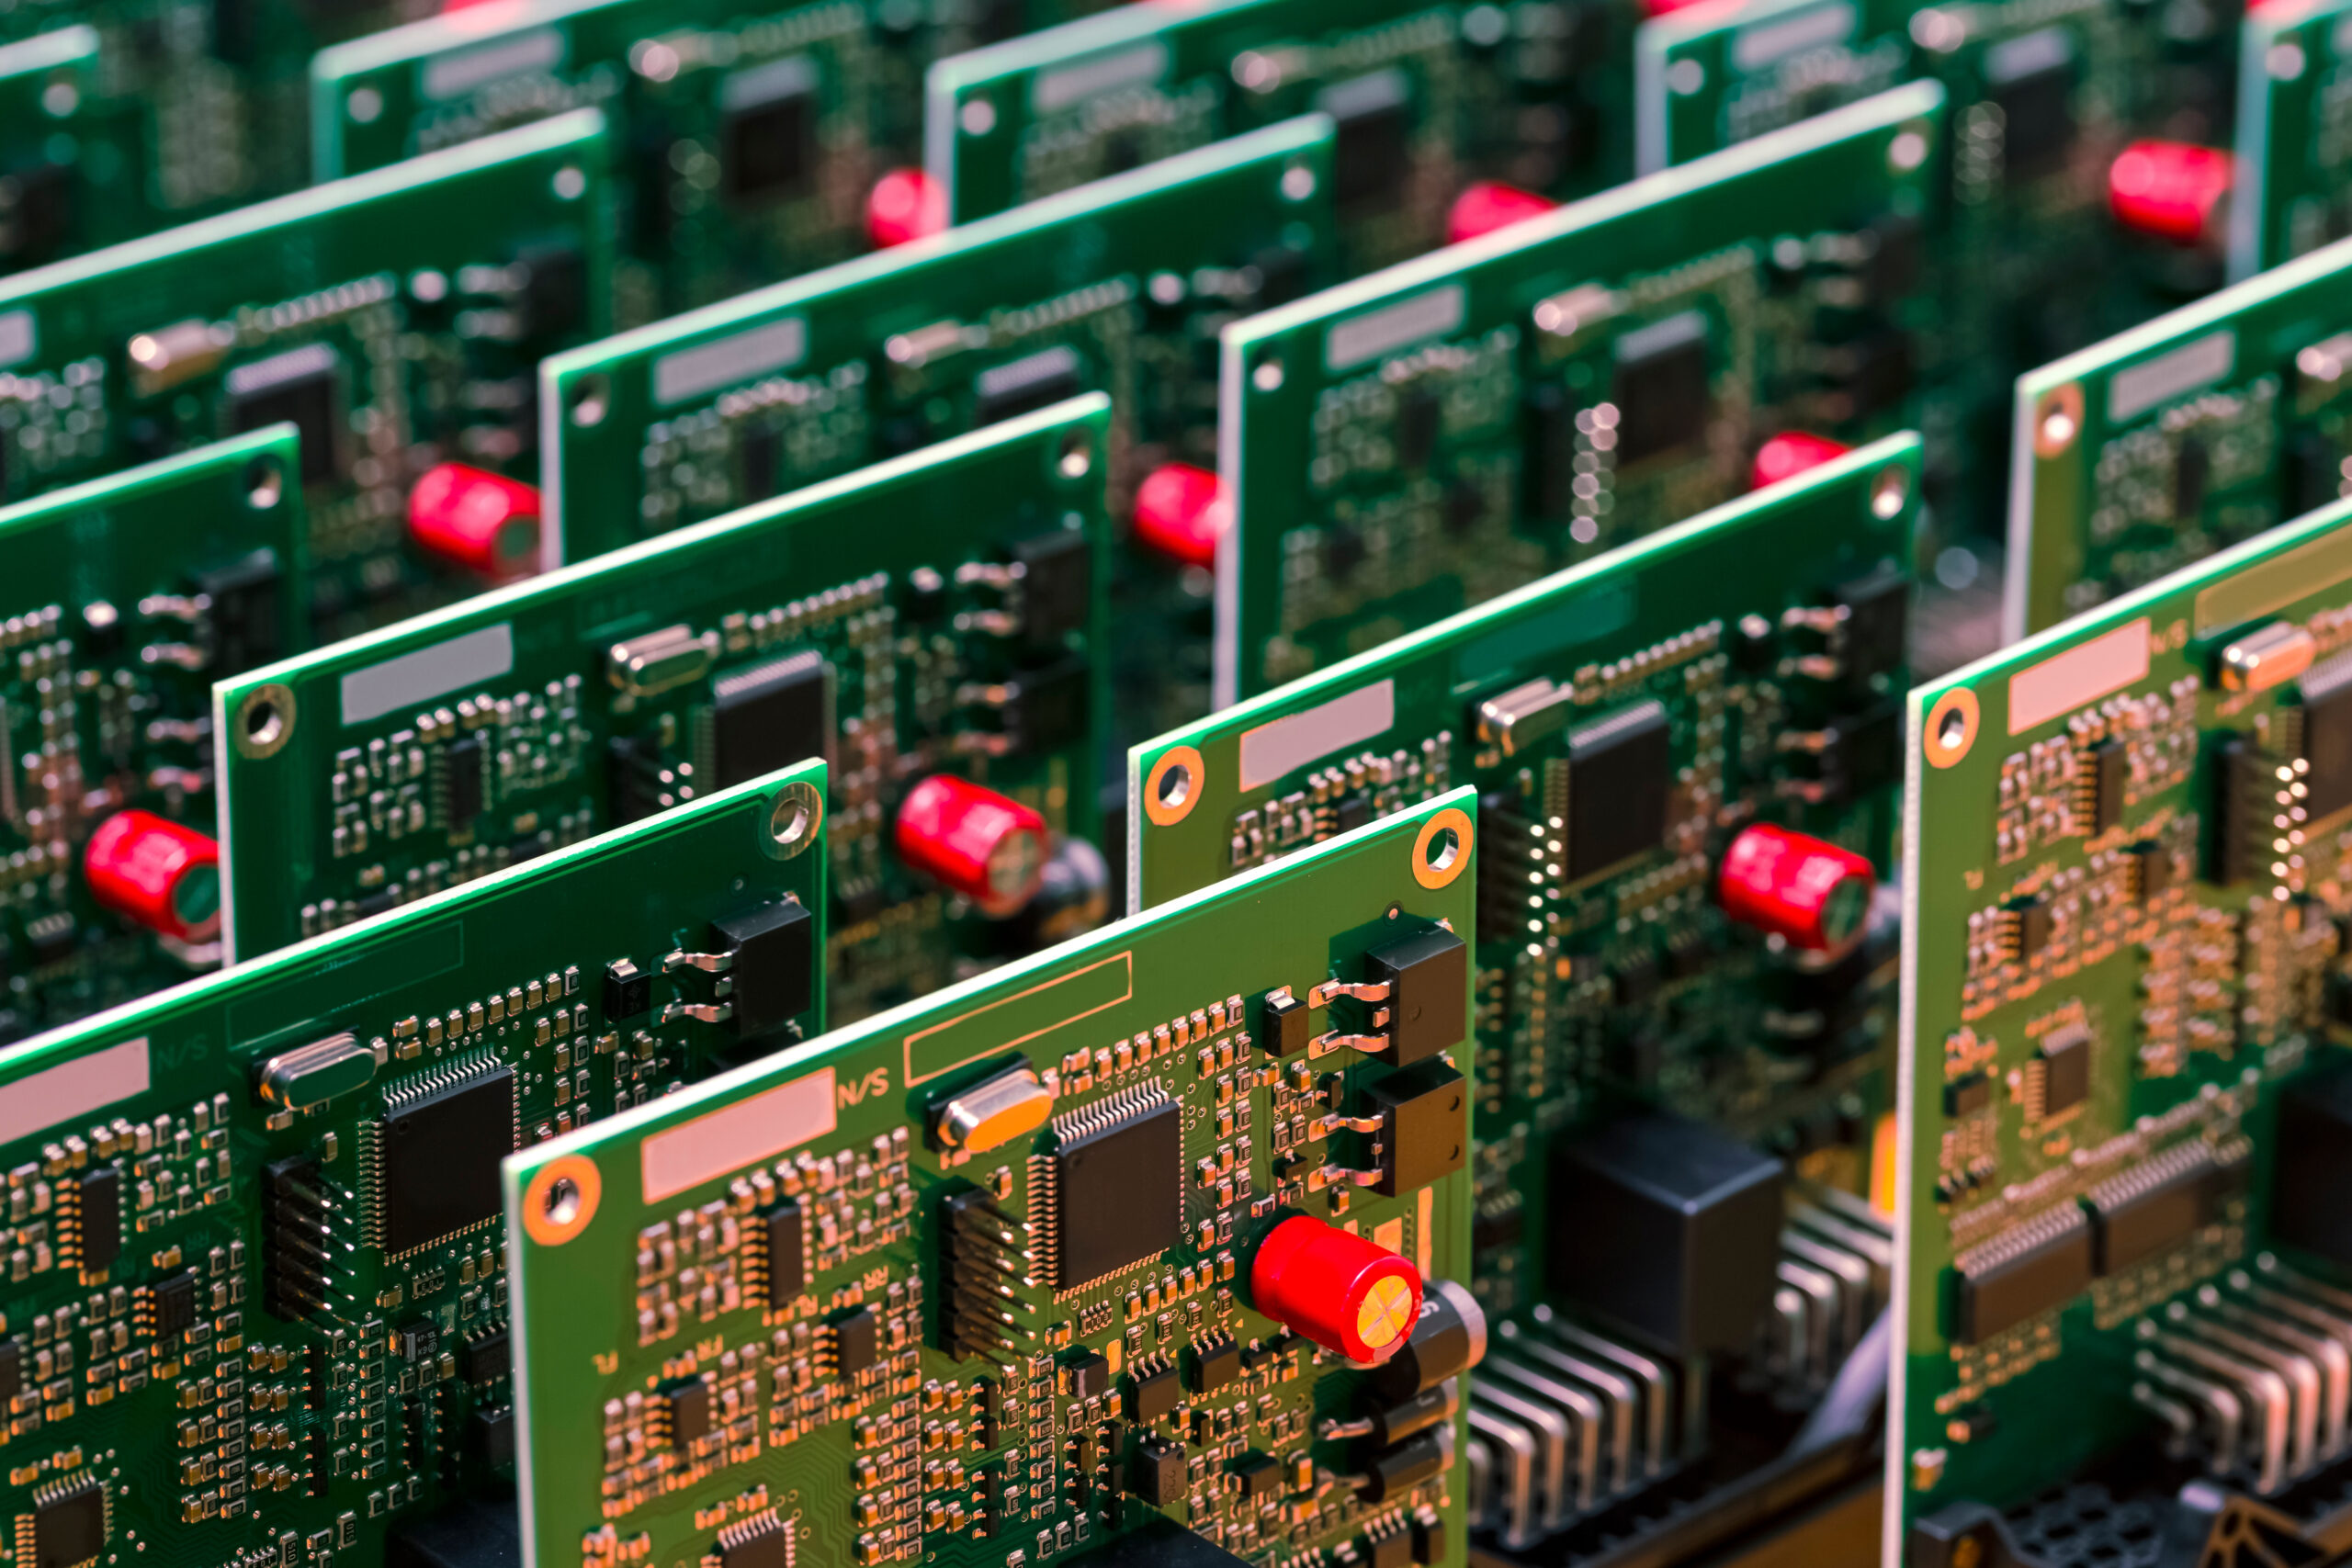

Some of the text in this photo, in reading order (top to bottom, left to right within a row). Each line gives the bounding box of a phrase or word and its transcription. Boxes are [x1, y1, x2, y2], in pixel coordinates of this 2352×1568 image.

[156, 1032, 209, 1073] N/S
[837, 1066, 889, 1110] N/S
[863, 1265, 888, 1292] RR
[1091, 1314, 1109, 1325] 103
[1163, 1324, 1171, 1337] 182
[345, 1522, 355, 1542] 510
[288, 1542, 297, 1561] 510
